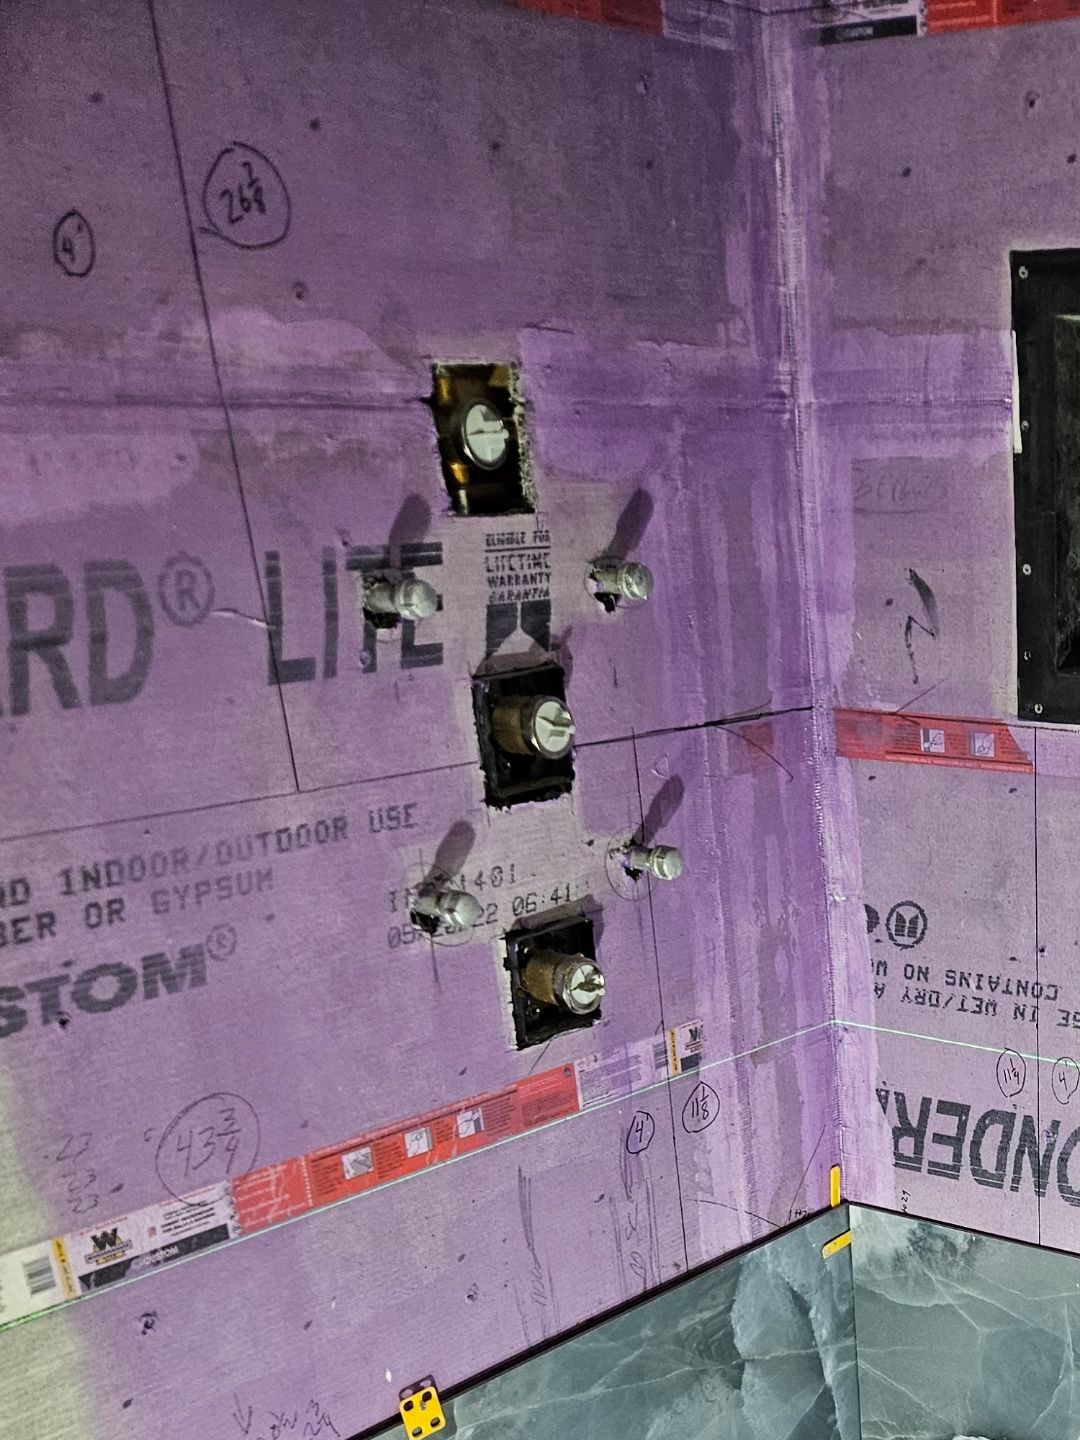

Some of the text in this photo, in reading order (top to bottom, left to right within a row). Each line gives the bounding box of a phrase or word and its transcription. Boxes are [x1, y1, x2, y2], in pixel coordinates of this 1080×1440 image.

[486, 571, 552, 589] WARRANTY
[368, 803, 418, 833] USE
[84, 897, 126, 928] OR
[151, 867, 274, 915] GYPSUM
[903, 963, 930, 983] NO
[945, 969, 1059, 1001] CONTAINS
[1013, 1002, 1040, 1023] IN
